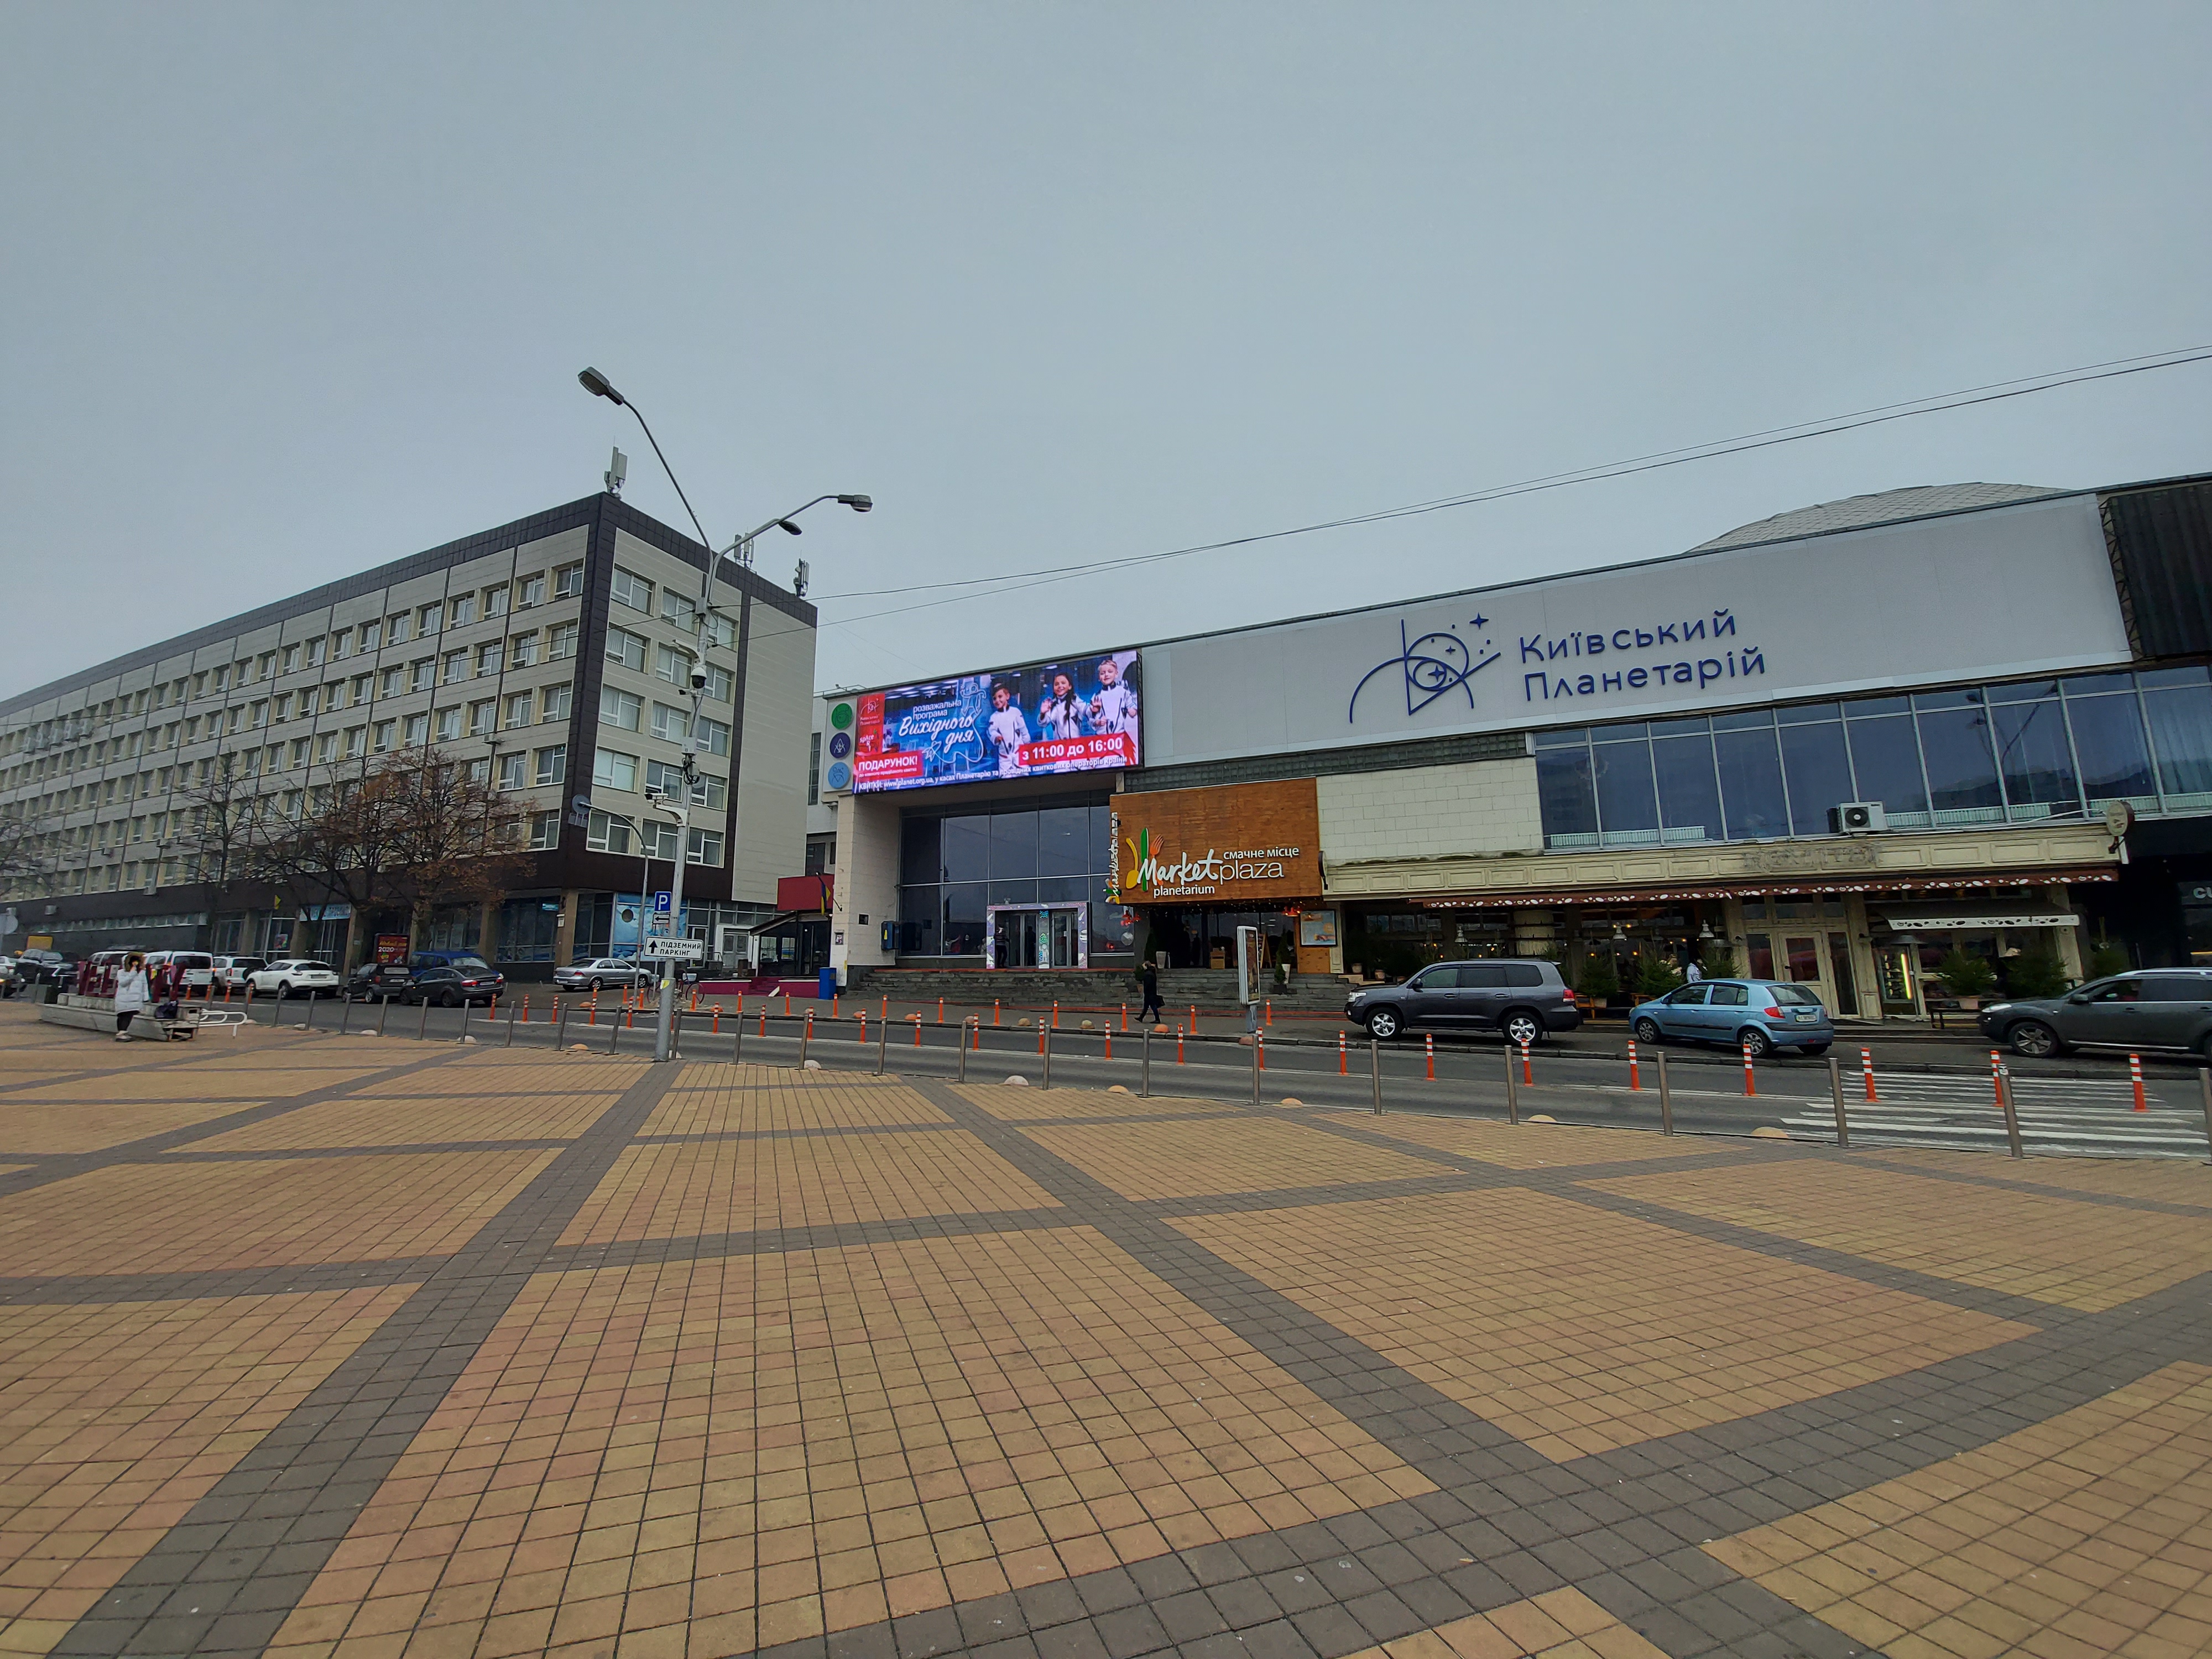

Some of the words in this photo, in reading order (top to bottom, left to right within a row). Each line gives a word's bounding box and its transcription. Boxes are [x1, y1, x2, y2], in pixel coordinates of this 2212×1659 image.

[1520, 608, 1736, 663] Київський
[1525, 646, 1765, 701] Планетарій
[913, 700, 962, 713] розважальна
[913, 709, 948, 721] програма
[899, 715, 973, 740] Вихідного
[943, 729, 974, 753] дня
[1022, 751, 1029, 760] з
[1032, 744, 1065, 759] 11:00
[1067, 745, 1084, 757] до
[1088, 737, 1123, 753] 16:00
[858, 755, 918, 771] ПОДАРУНОК!
[1032, 763, 1066, 772] квиткових
[1066, 758, 1103, 770] операторів
[1223, 849, 1264, 860] смачне
[1266, 846, 1300, 859] місце
[1137, 849, 1223, 885] Market
[1219, 859, 1284, 885] plaza
[1154, 885, 1215, 899] planetarium
[658, 895, 668, 910] P
[661, 941, 701, 950] ПІДЗЕМНИЙ
